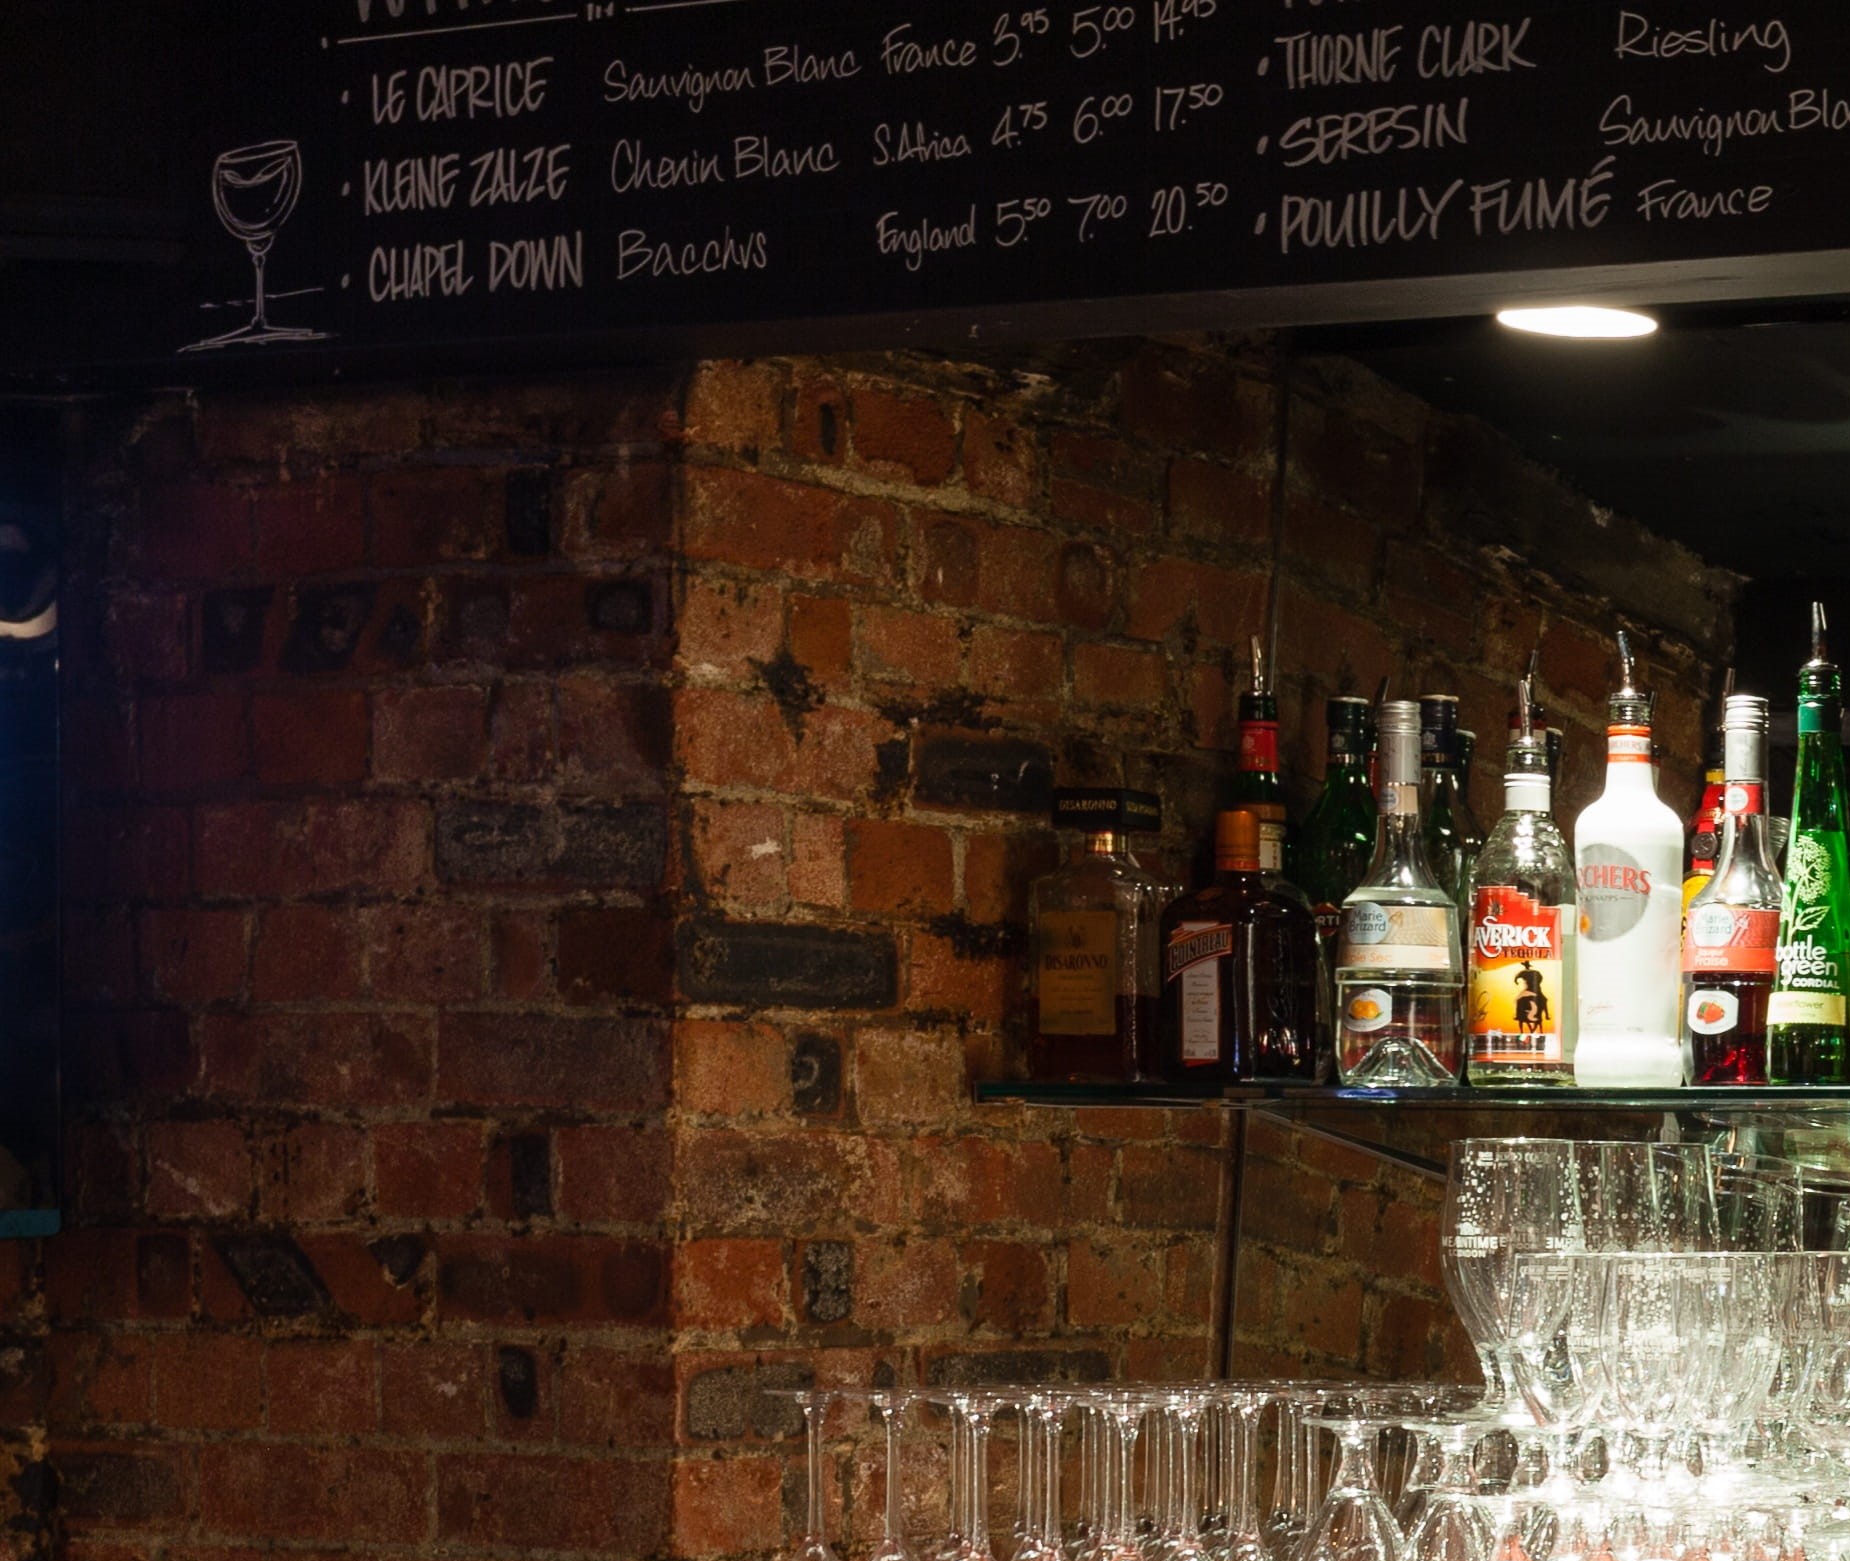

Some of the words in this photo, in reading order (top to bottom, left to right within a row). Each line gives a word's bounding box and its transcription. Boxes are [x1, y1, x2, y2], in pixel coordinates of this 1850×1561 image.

[372, 70, 407, 125] LE
[417, 57, 555, 120] CAPRICE
[603, 59, 755, 113] Sauvignon
[764, 45, 863, 87] Blanc
[882, 23, 977, 75] France
[992, 8, 1049, 66] 3.95
[1070, 5, 1135, 58] 5.00
[1274, 25, 1403, 89] THORNE
[1416, 17, 1538, 79] CLARK
[1615, 10, 1792, 73] Riesling
[1279, 97, 1469, 167] SERESIN
[1599, 94, 1783, 156] Sauvignon
[364, 152, 461, 216] KLEINE
[468, 144, 572, 207] ZALZE
[611, 139, 725, 193] Chenin
[733, 136, 842, 179] Blanc
[992, 102, 1048, 151] 4.75
[1073, 93, 1133, 145] 6.00
[1154, 83, 1224, 132] 17.50
[1282, 178, 1464, 253] POUILLY
[1470, 156, 1616, 236] FUMÉ
[1637, 179, 1774, 221] France
[368, 240, 474, 302] CHAPEL
[488, 230, 583, 291] DOWN
[877, 204, 976, 271] England
[995, 198, 1051, 247] 5.50
[1067, 193, 1127, 243] 7.00
[1149, 182, 1228, 239] 20.50
[1349, 921, 1387, 932] Brizard
[1352, 910, 1384, 922] Marie
[1474, 916, 1552, 958] AVERICK
[1502, 948, 1553, 959] TEQUILA
[1775, 934, 1828, 962] bottle
[1045, 953, 1109, 970] DISARONNO
[1781, 953, 1839, 986] green
[1791, 977, 1841, 989] CORDIAL
